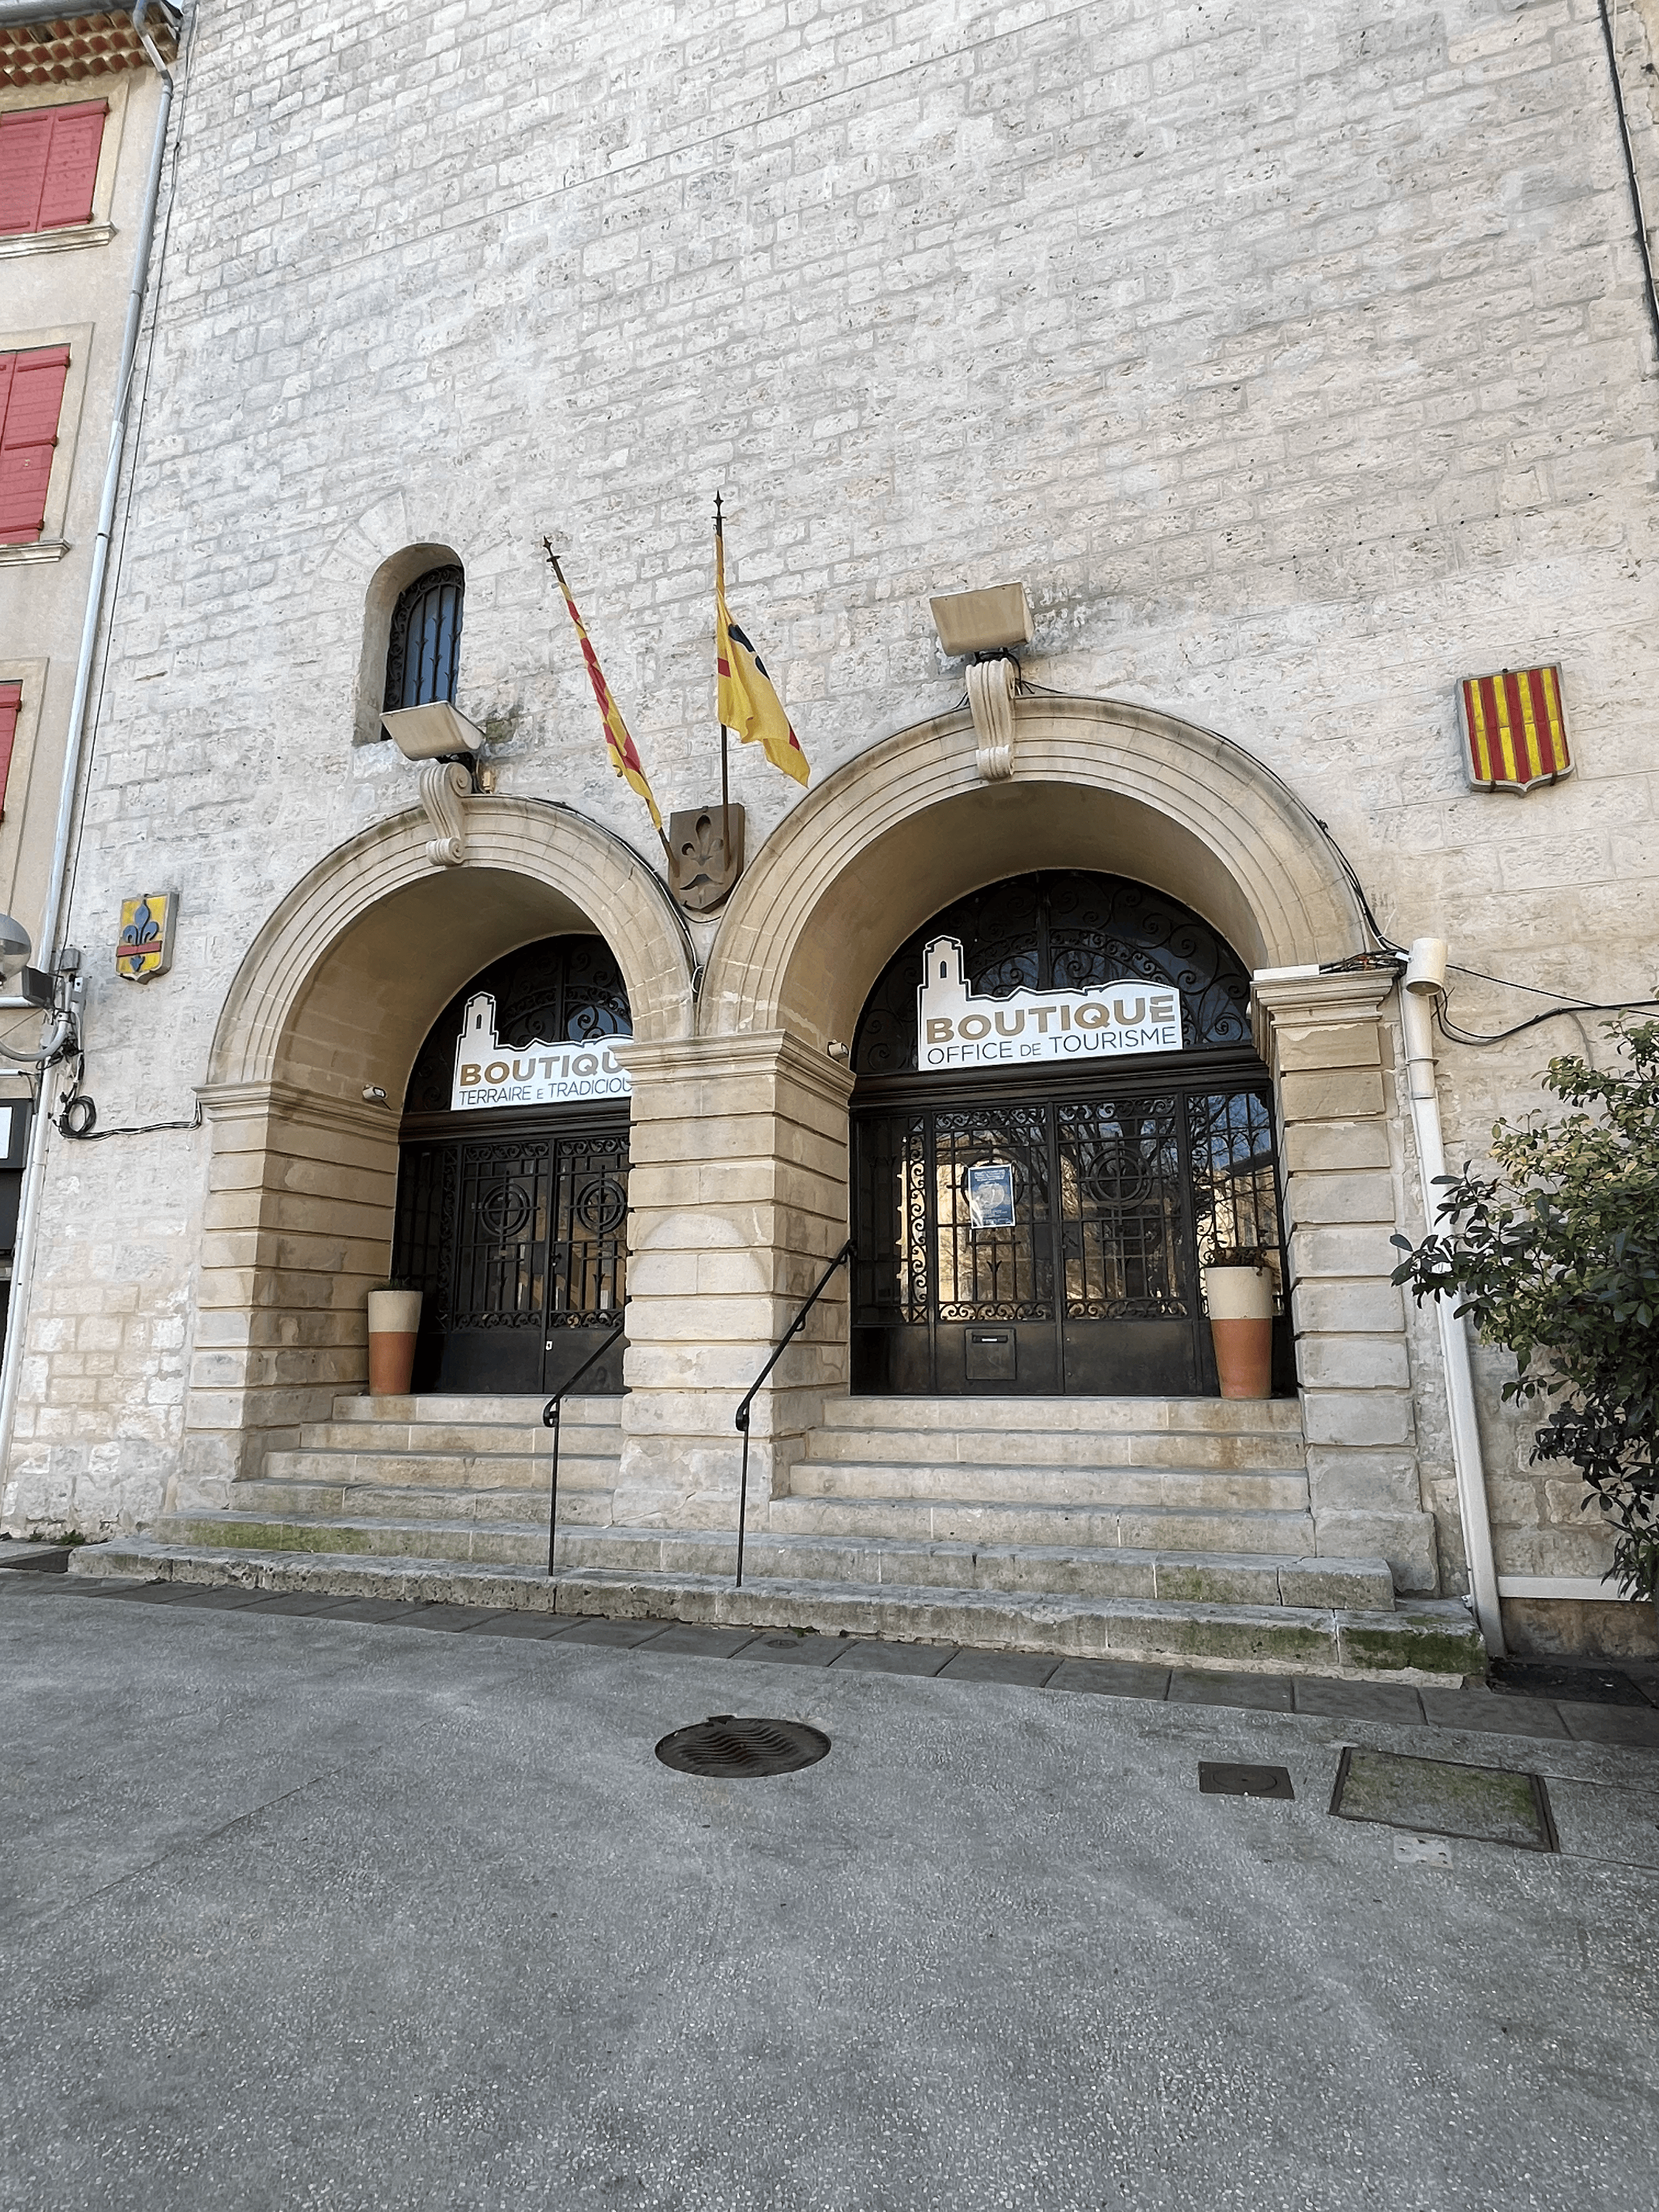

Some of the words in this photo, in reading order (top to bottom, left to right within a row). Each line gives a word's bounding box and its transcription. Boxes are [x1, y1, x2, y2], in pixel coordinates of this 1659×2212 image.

[927, 995, 1175, 1044] BOUTIQUE
[928, 1041, 1013, 1064] OFFICE
[1020, 1043, 1042, 1057] DE
[1048, 1026, 1177, 1053] TOURISME
[460, 1052, 624, 1086] BOUTIQU
[459, 1086, 532, 1105] TERRAIRE
[537, 1088, 544, 1099] E
[548, 1077, 632, 1098] TRADICIOU
